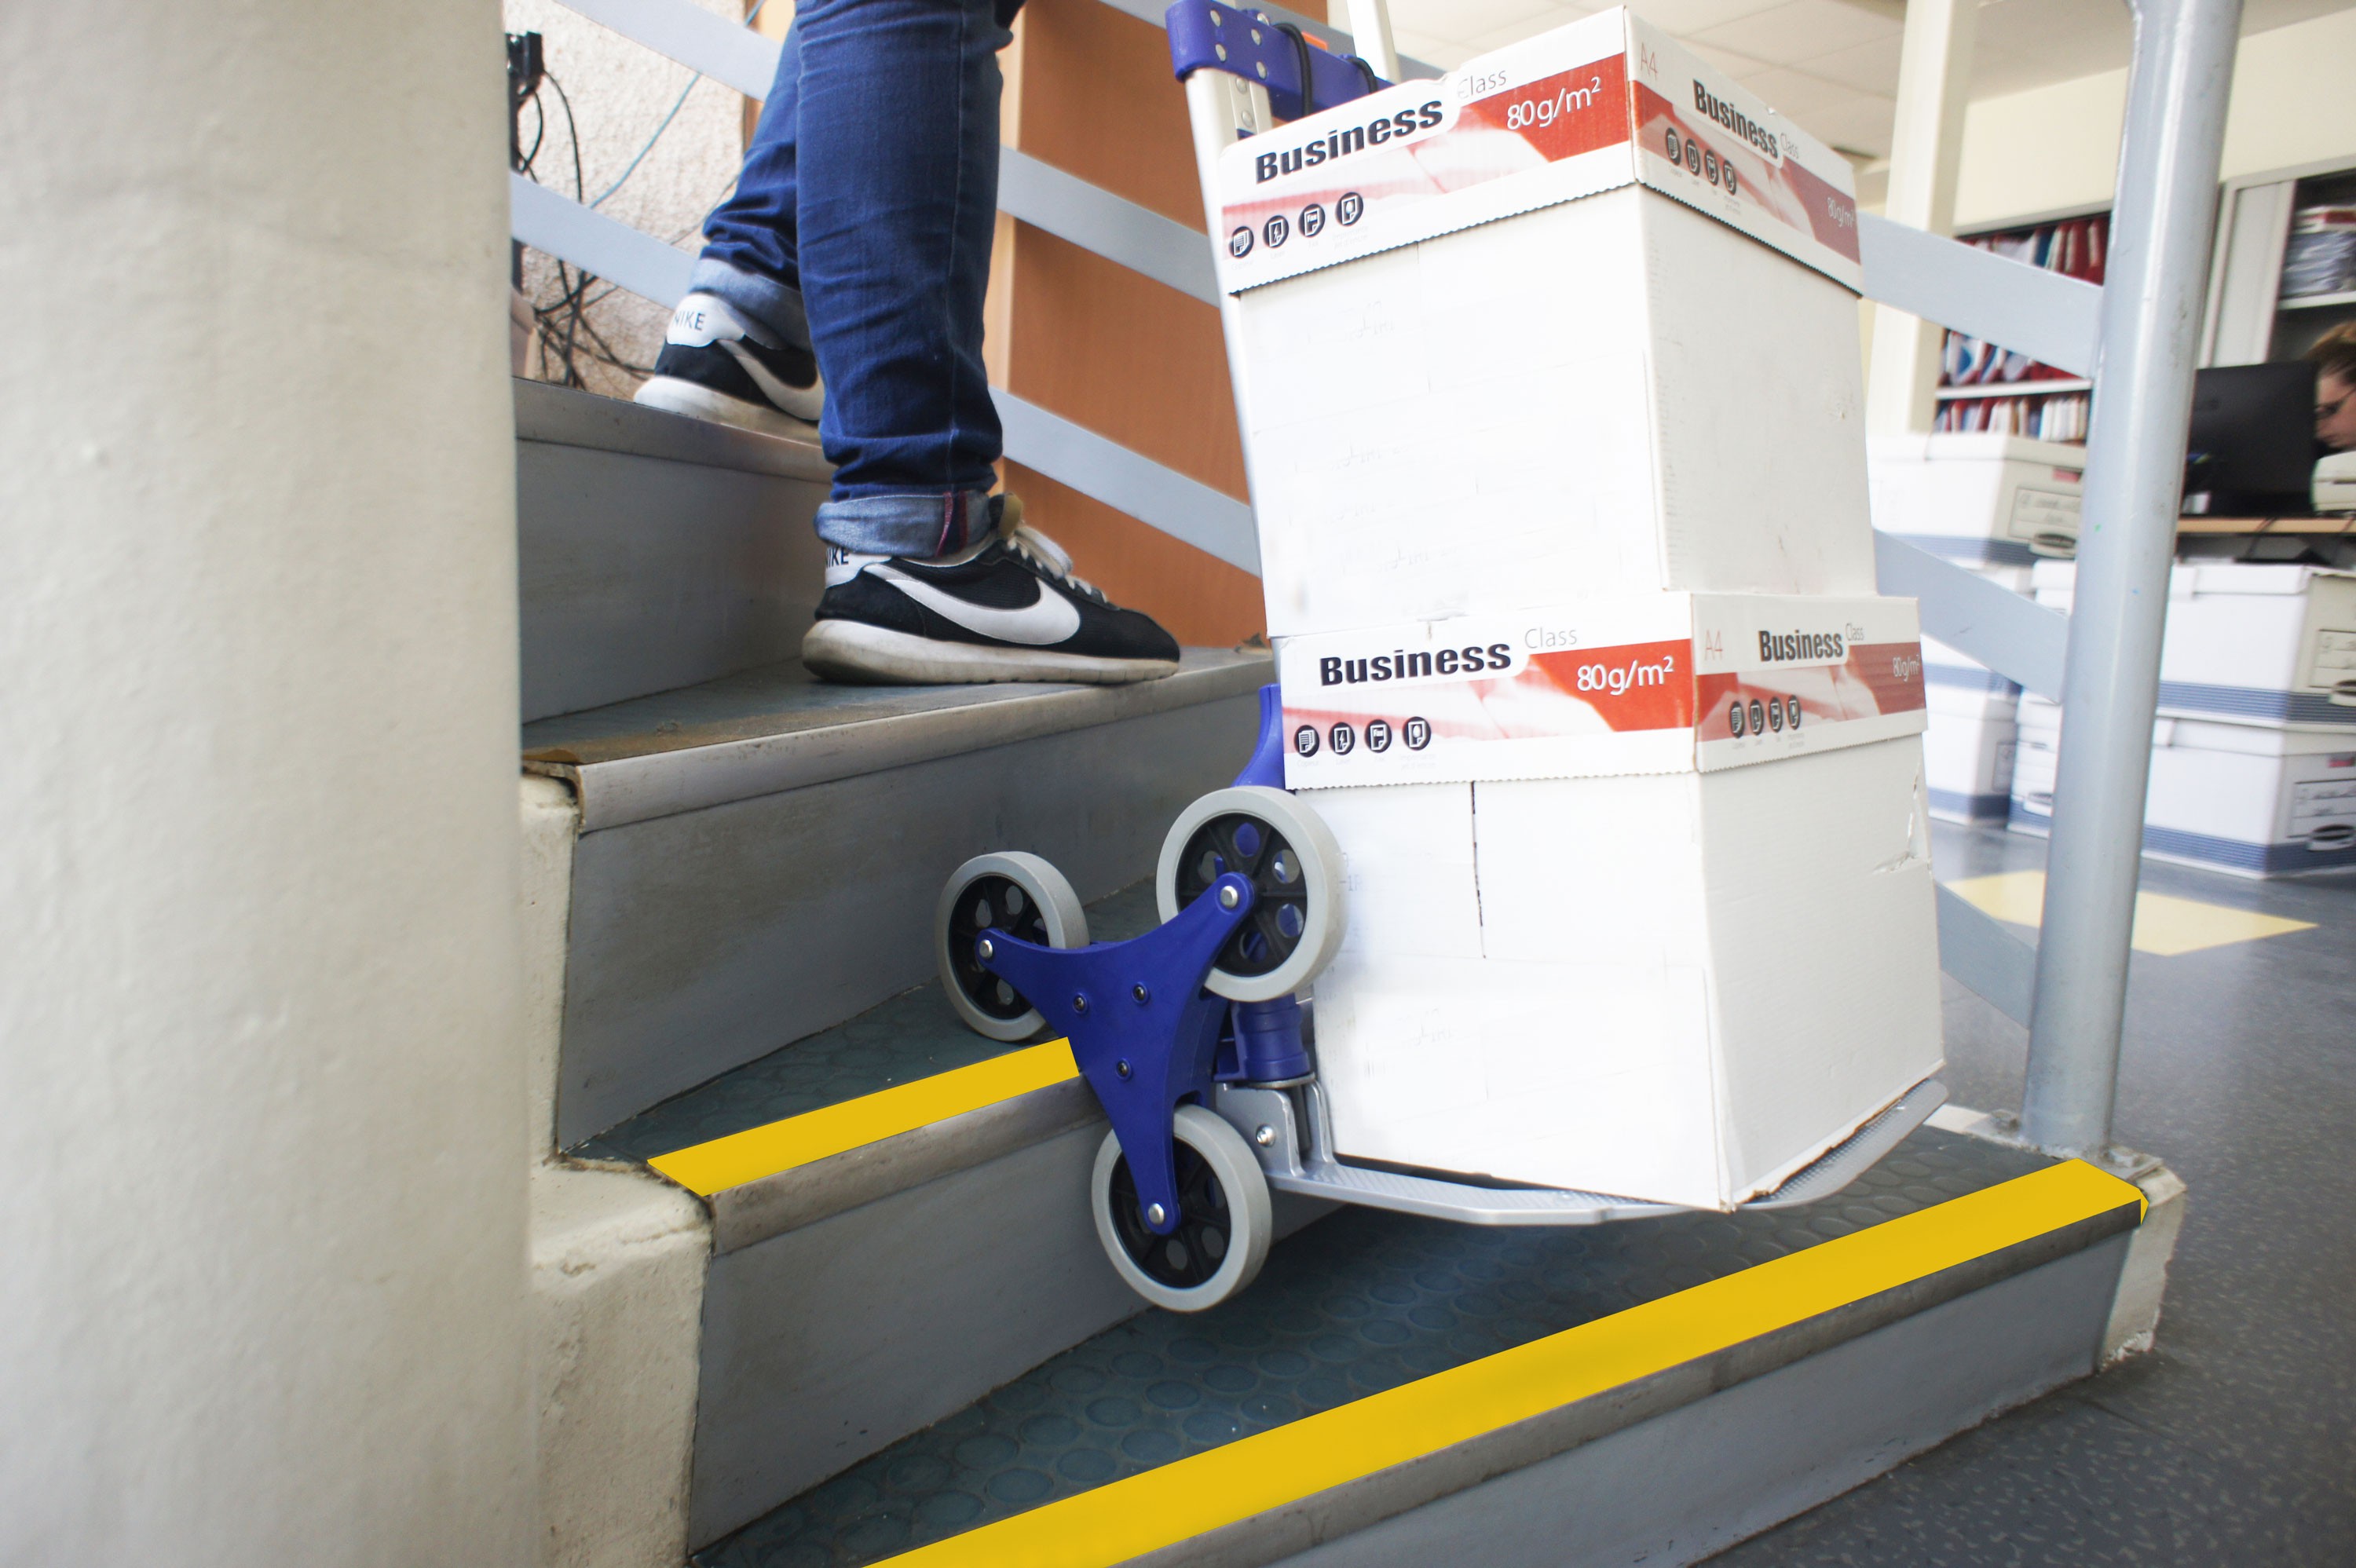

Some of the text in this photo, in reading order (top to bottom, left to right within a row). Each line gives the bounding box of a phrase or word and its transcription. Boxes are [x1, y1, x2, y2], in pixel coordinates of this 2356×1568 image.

[1639, 42, 1659, 81] A4
[1506, 76, 1601, 130] 80g/m²
[1693, 78, 1799, 159] Business Class
[1256, 68, 1507, 184] Business Class
[672, 312, 706, 331] NIKE
[1320, 628, 1579, 686] Business Class
[1704, 630, 1723, 661] A4
[1758, 623, 1864, 663] Business Class
[1576, 655, 1675, 696] 80g/m²
